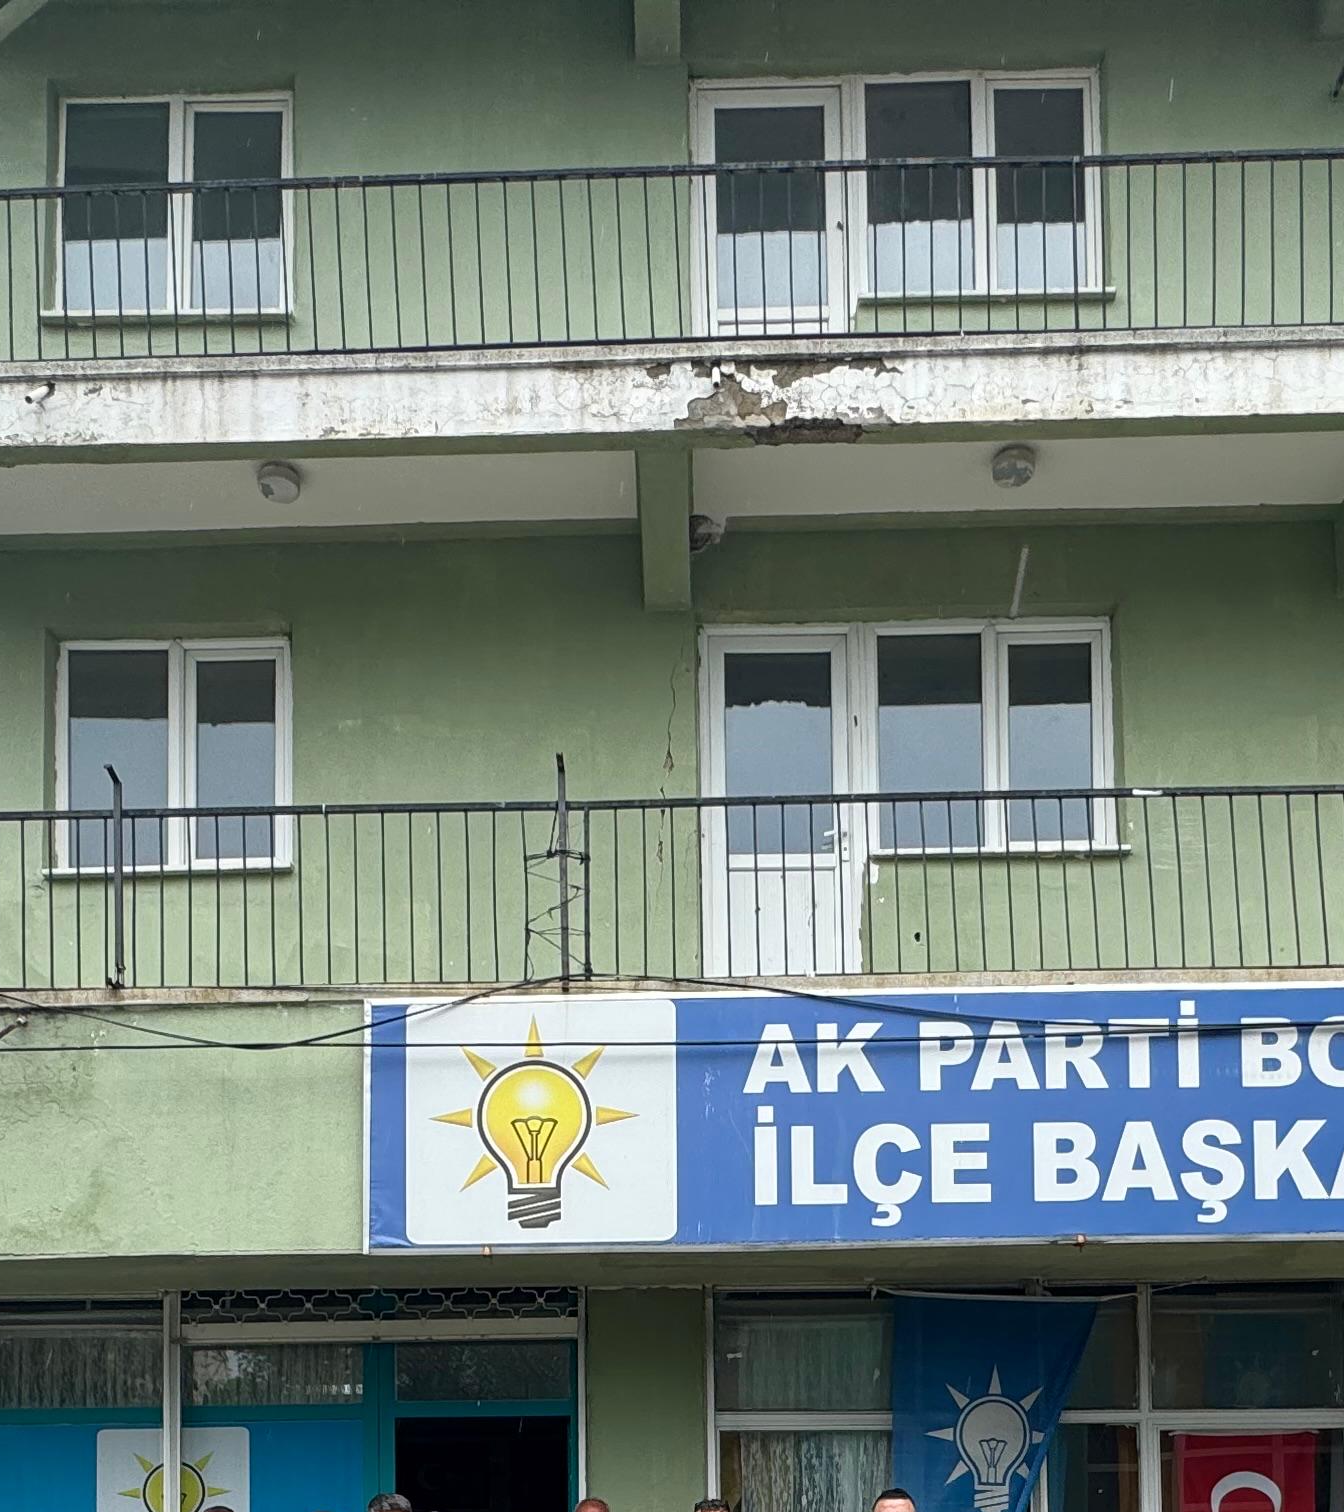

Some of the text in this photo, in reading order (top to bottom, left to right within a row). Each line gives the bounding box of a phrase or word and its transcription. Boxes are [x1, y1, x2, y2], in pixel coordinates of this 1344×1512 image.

[743, 1022, 885, 1094] AK
[919, 1000, 1200, 1091] PARTİ
[753, 1105, 992, 1227] İLÇE
